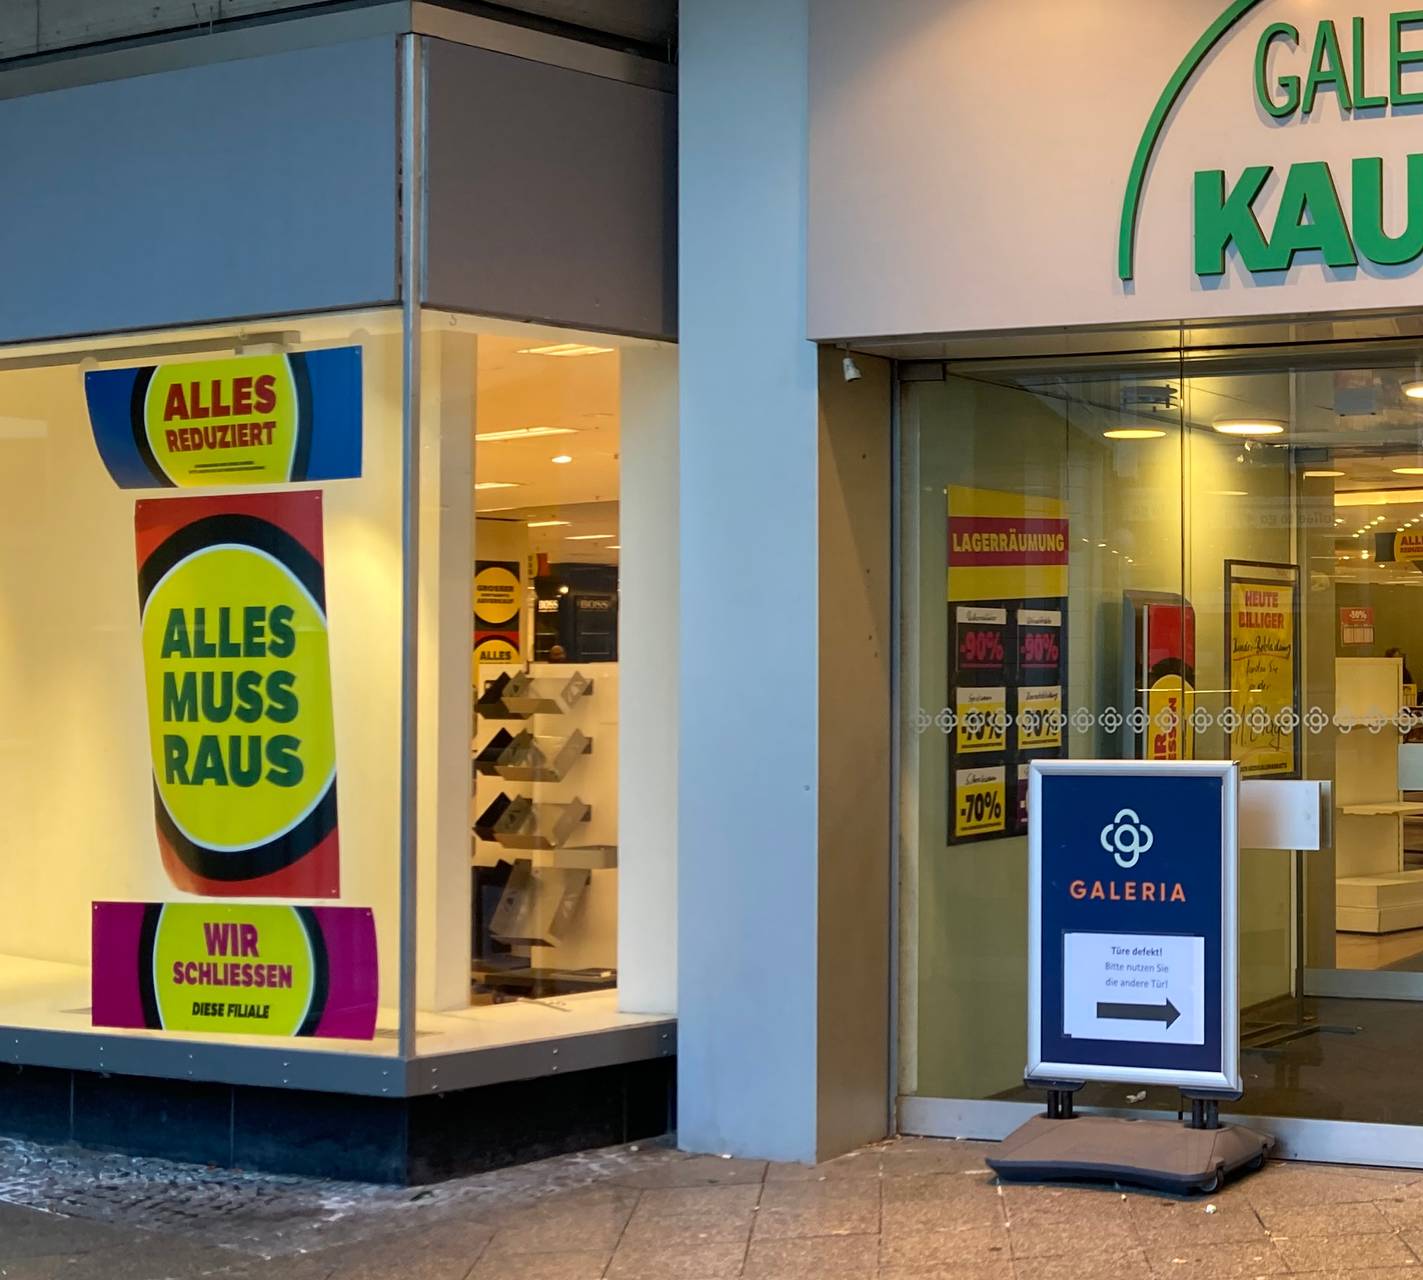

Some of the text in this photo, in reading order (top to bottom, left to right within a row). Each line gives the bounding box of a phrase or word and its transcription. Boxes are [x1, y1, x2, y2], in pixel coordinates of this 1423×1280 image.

[163, 374, 277, 421] ALLES
[165, 421, 277, 453] REDUZIERT
[953, 528, 1065, 552] LAGERRÄUMUNG
[580, 600, 609, 609] BOSS
[1245, 590, 1279, 608] HEUTE
[161, 604, 296, 659] ALLES
[1238, 611, 1285, 629] BILLIGER
[480, 651, 511, 660] ALLES
[960, 631, 1004, 661] -90%
[163, 670, 299, 723] MUSS
[163, 734, 304, 788] RAUS
[961, 790, 1002, 823] -70%
[1069, 880, 1186, 902] GALERIA
[203, 922, 260, 958] WIR
[1111, 946, 1163, 957] Türe defekt!
[172, 960, 293, 989] SCHLIESSEN
[1105, 961, 1169, 974] Bitte nutzen Sie
[1105, 977, 1119, 988] die
[1120, 979, 1149, 989] andere
[192, 1001, 271, 1019] DIESE FILIALE
